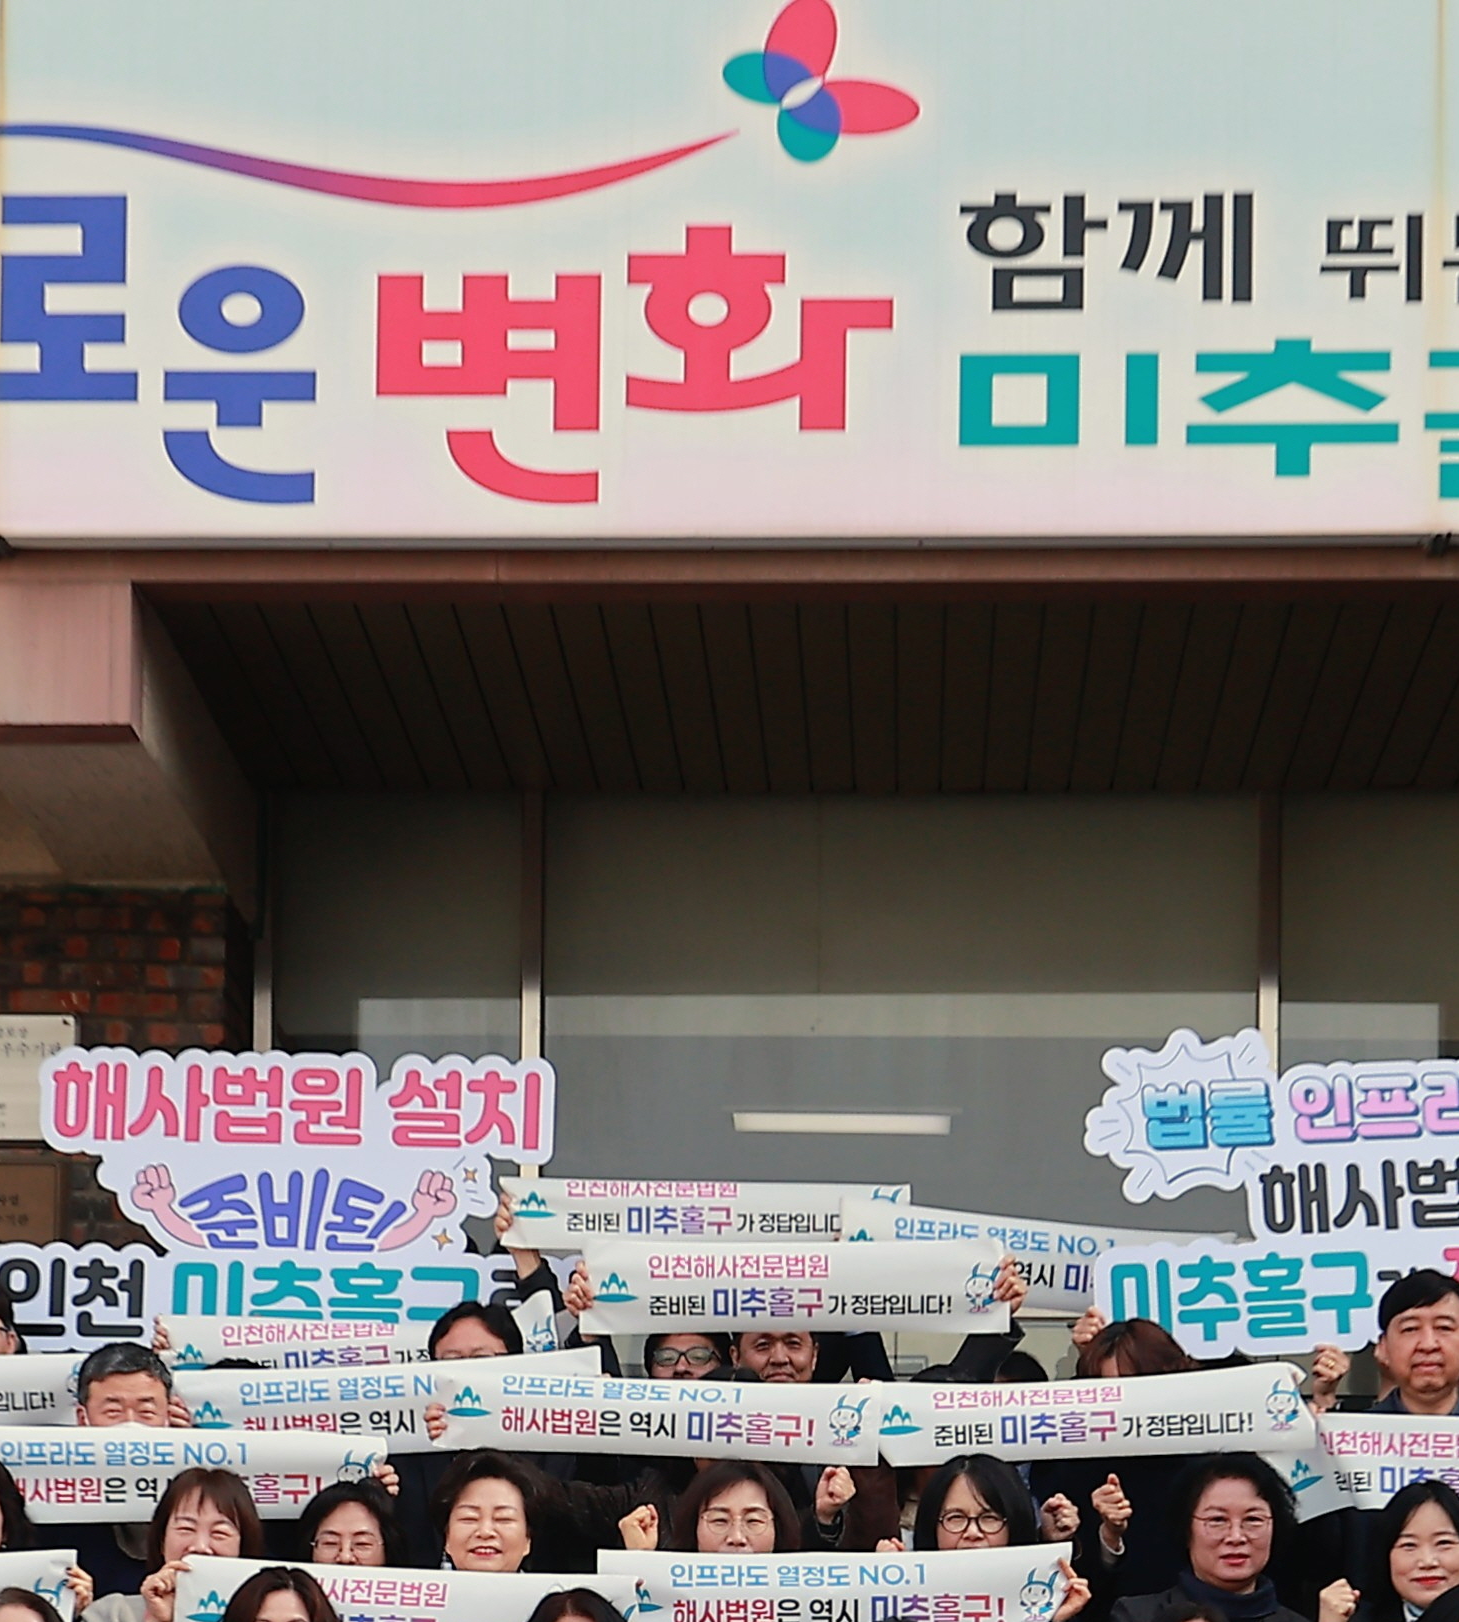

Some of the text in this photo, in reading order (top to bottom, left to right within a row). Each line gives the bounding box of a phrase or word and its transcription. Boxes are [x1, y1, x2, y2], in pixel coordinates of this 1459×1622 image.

[957, 188, 1254, 312] 함께
[375, 221, 893, 504] 변화
[52, 1062, 539, 1150] 해사법원 설치
[1141, 1081, 1276, 1150] 법률
[566, 1179, 738, 1198] 인천해사전문법원
[178, 1168, 407, 1254] 준비된
[566, 1212, 620, 1233] 준비된
[988, 1227, 1049, 1254] 열정도
[648, 1255, 829, 1280] 인천해사전문법원
[1, 1258, 143, 1340] 인천
[649, 1294, 706, 1317] 준비된
[851, 1294, 952, 1317] 정답입니다!
[222, 1321, 396, 1346] 인천해사전문법원
[240, 1376, 329, 1404] 인프라도
[337, 1373, 398, 1400] 열정도
[501, 1375, 742, 1404] 인프라도 열정도 NO.1
[932, 1386, 1122, 1409] 인천해사전문법원
[369, 1409, 417, 1436] 역시
[500, 1407, 814, 1448] 해사법원은 역시 미추홀구!
[933, 1422, 993, 1448] 준비된
[1146, 1411, 1254, 1440] 정답입니다!
[0, 1441, 248, 1466] 인프라도 열정도 NO.1
[670, 1564, 926, 1589] 인프라도 열정도 NO.1
